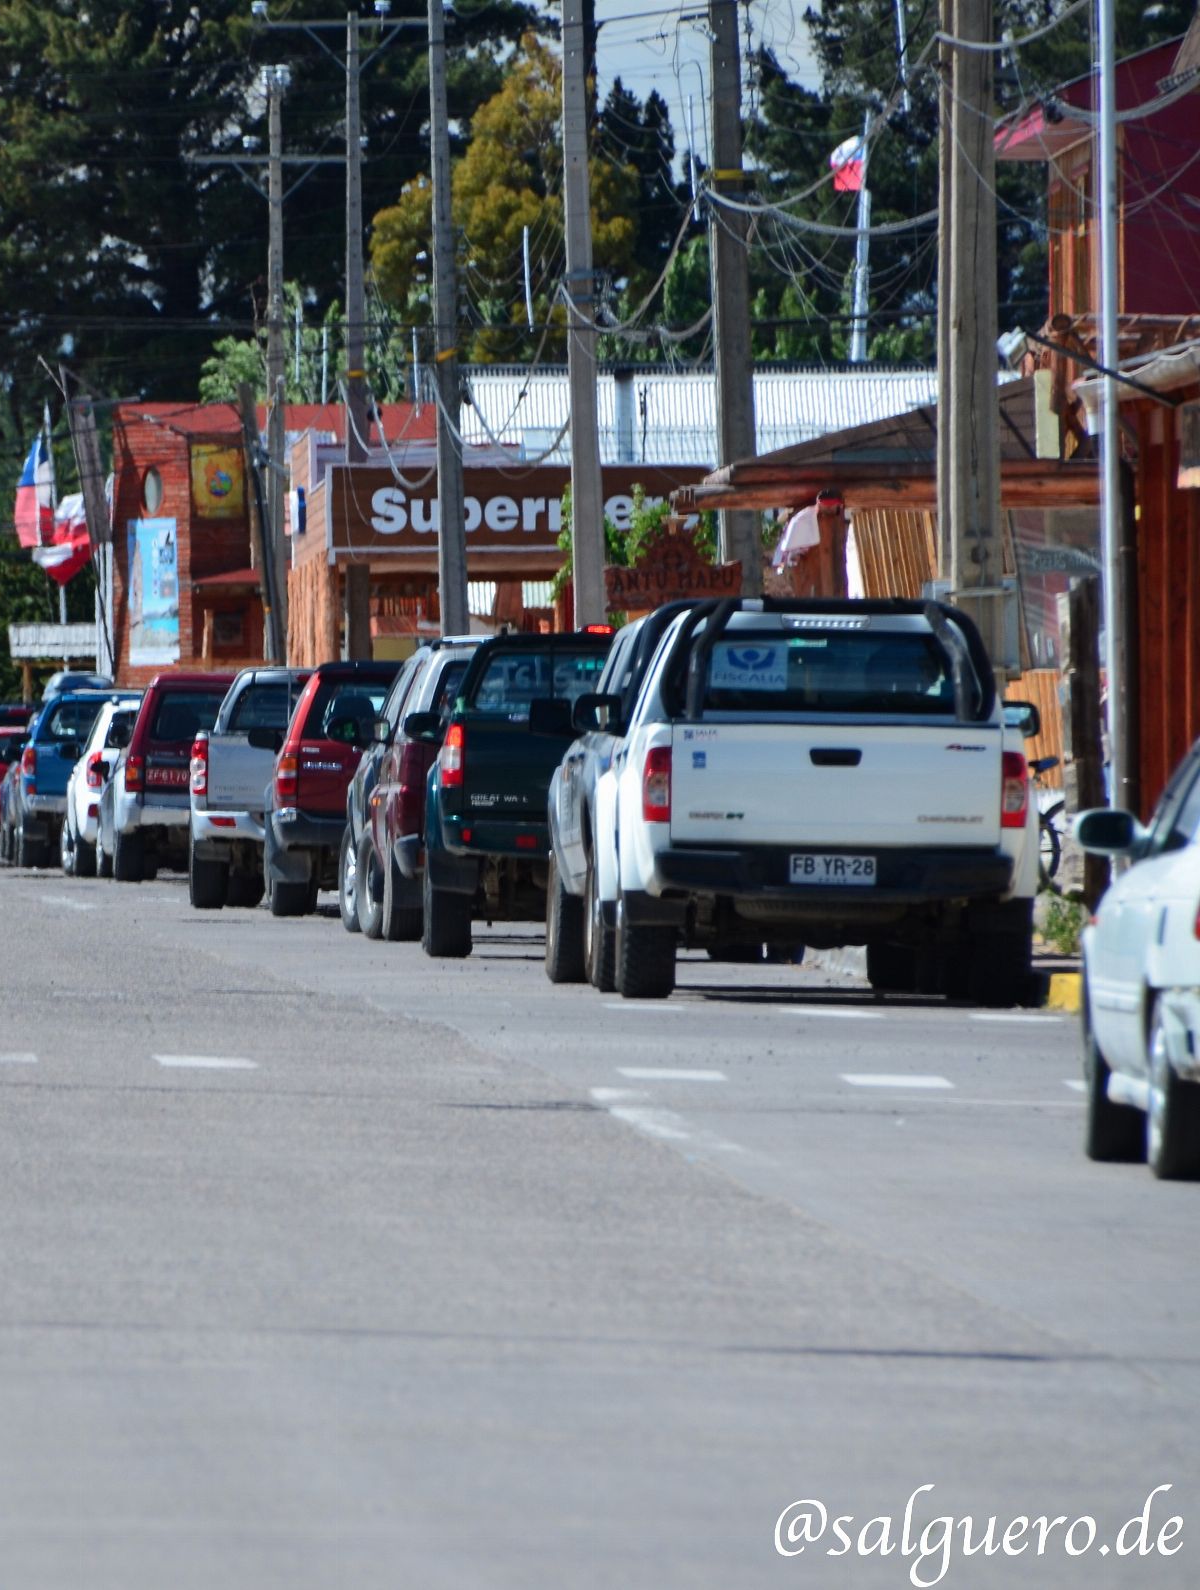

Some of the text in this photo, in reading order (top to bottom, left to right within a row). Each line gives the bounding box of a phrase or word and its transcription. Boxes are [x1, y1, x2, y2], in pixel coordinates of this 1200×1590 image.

[714, 672, 786, 684] FISCALIA
[504, 796, 529, 804] WAL
[792, 856, 875, 876] FB YR-28
